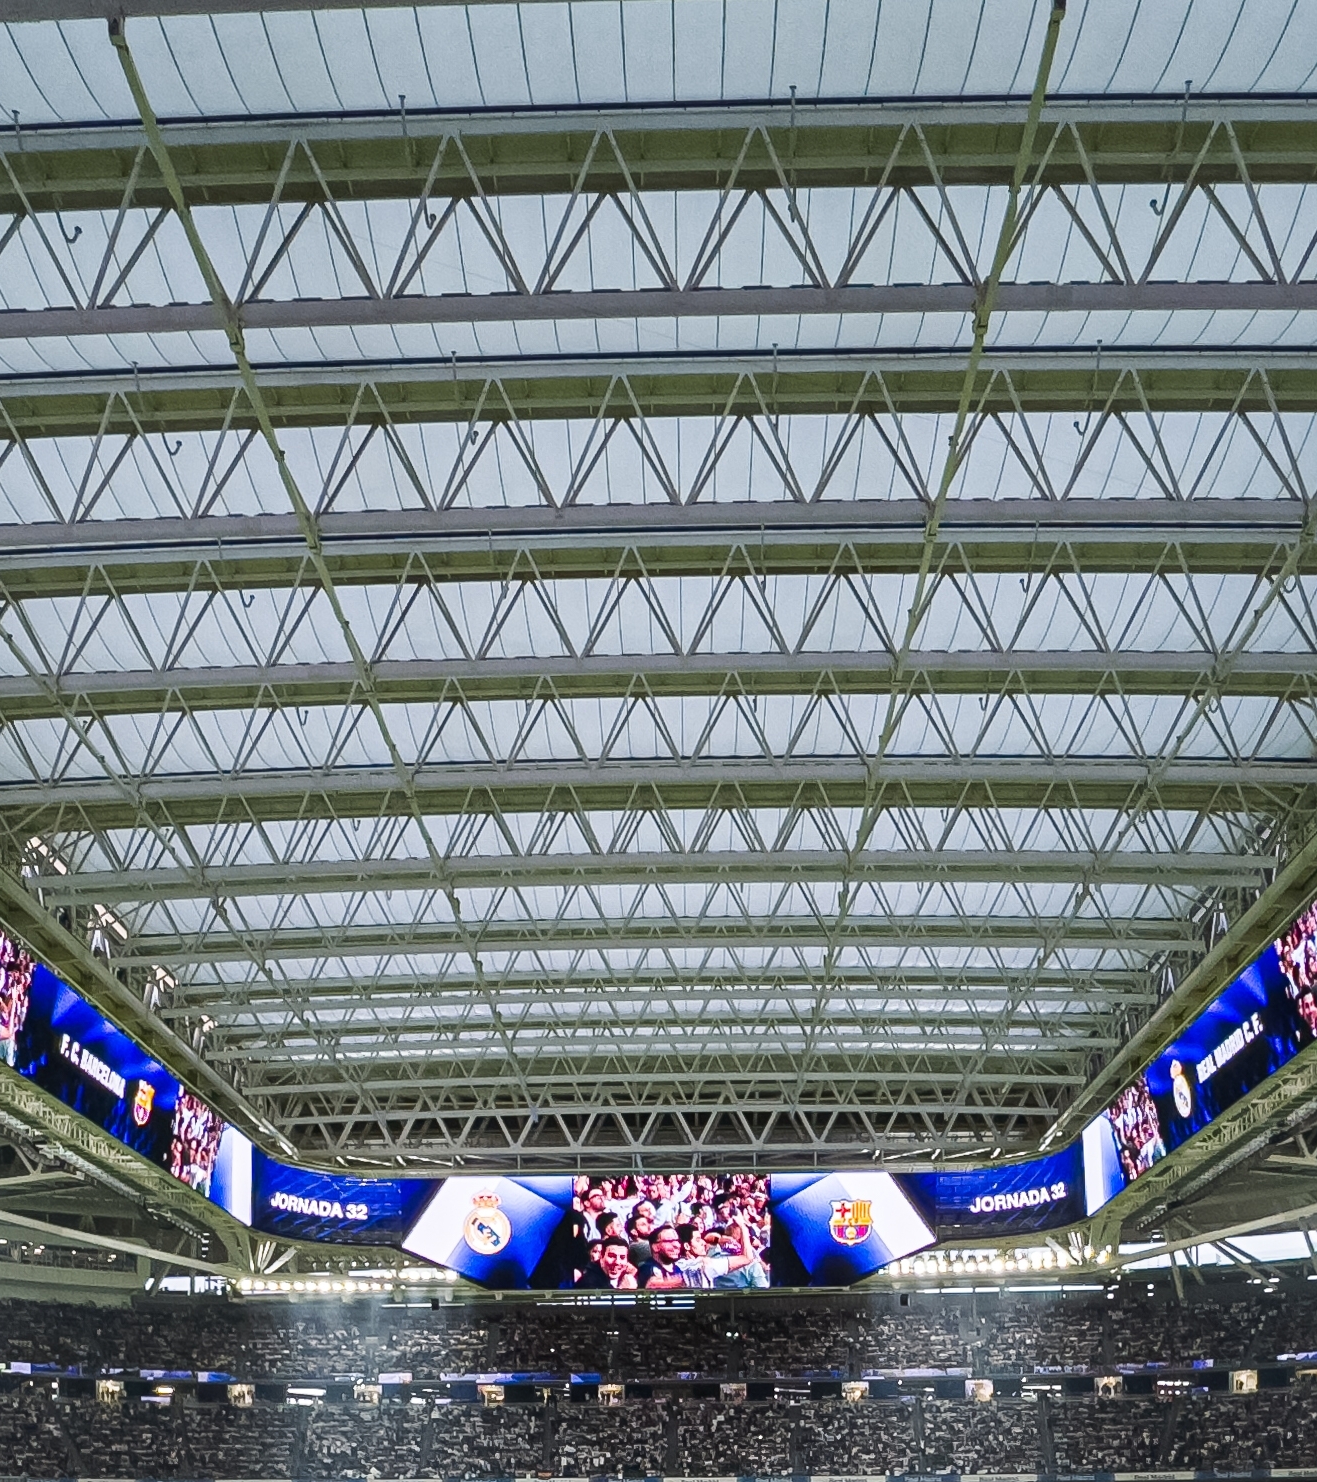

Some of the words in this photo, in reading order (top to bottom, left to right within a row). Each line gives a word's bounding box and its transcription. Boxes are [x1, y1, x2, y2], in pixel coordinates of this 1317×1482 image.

[271, 1192, 343, 1218] JORNADA
[345, 1204, 368, 1220] 32
[969, 1187, 1050, 1213] JORNADA
[1050, 1182, 1066, 1200] 32
